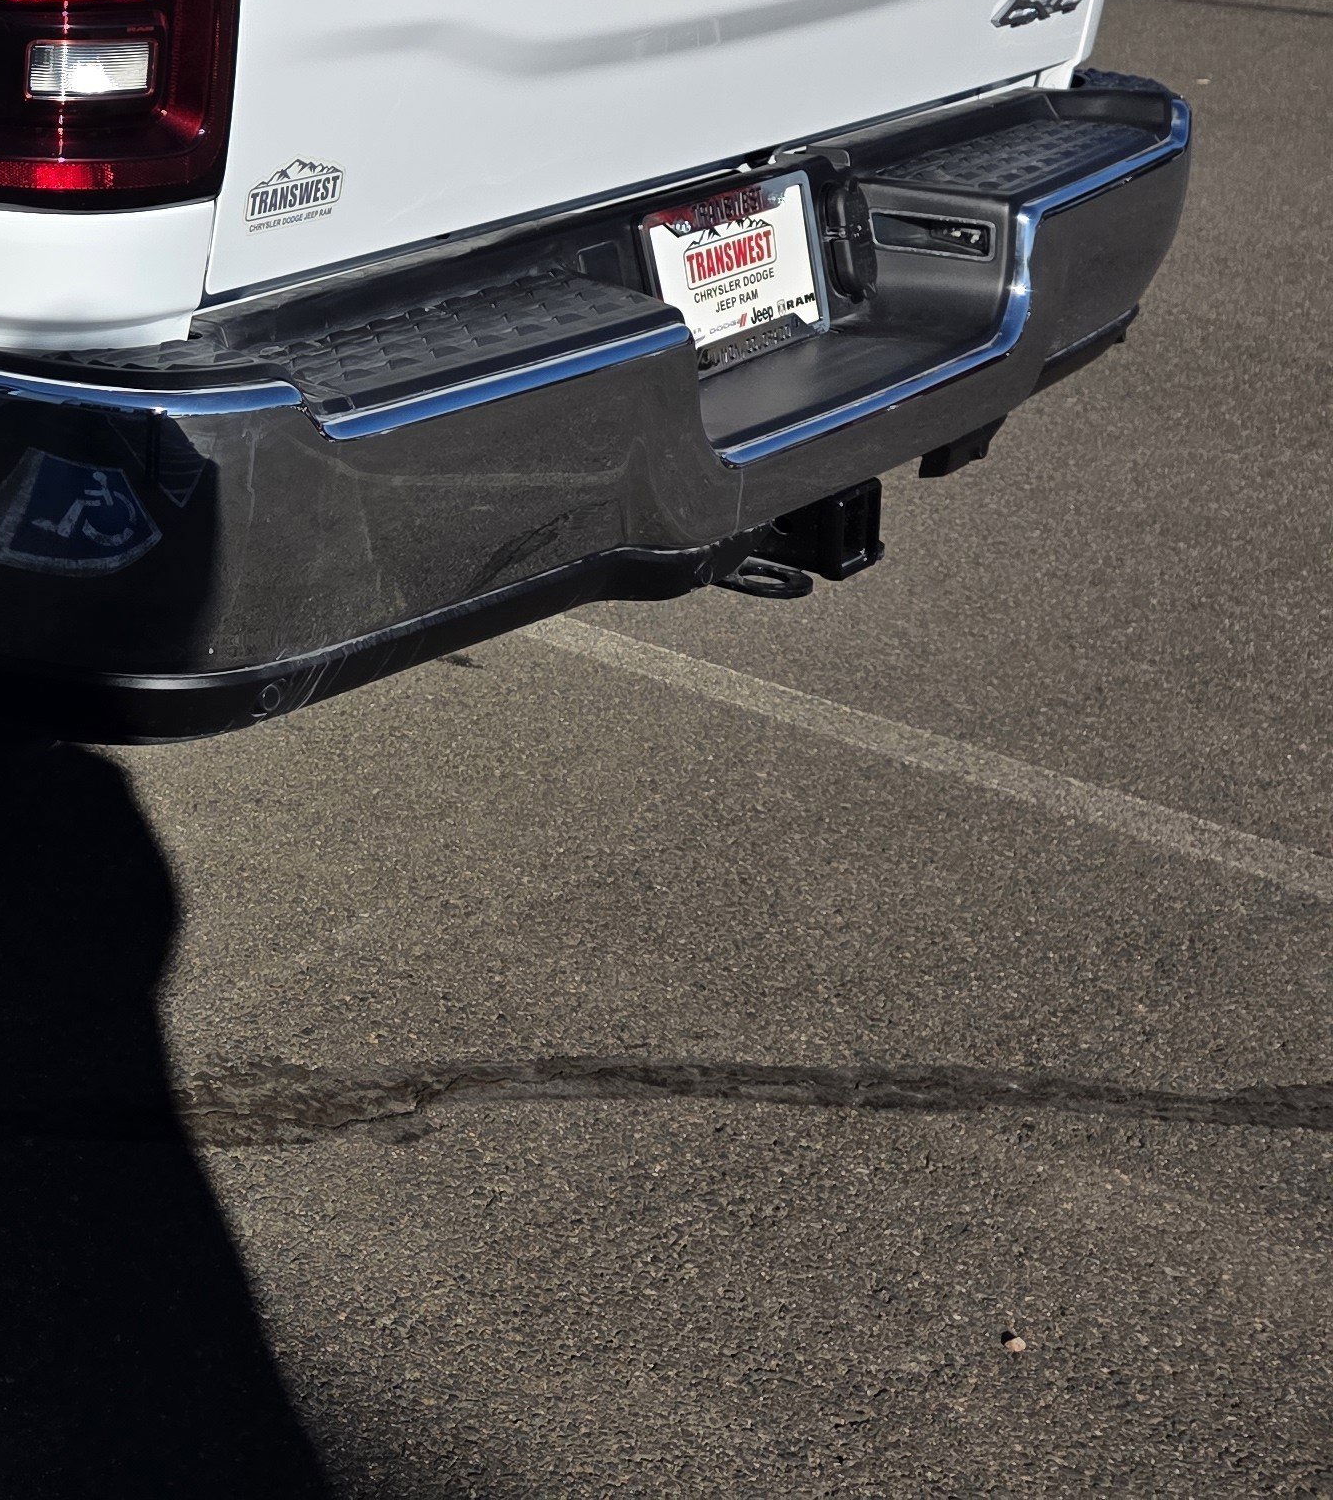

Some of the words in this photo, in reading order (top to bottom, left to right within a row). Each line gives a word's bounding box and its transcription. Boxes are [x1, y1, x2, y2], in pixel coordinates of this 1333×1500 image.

[250, 175, 340, 217] TRANSWEST
[249, 219, 281, 233] CHRYSLER
[282, 213, 303, 226] DODGE
[304, 209, 318, 221] JEEP
[318, 207, 333, 218] RAM
[686, 230, 773, 284] TRANSWEST
[693, 278, 742, 304] CHRYSLER
[743, 267, 775, 288] DODGE
[715, 296, 737, 314] JEEP
[739, 289, 759, 305] RAM
[751, 305, 774, 325] Jeep
[787, 292, 816, 311] RAM
